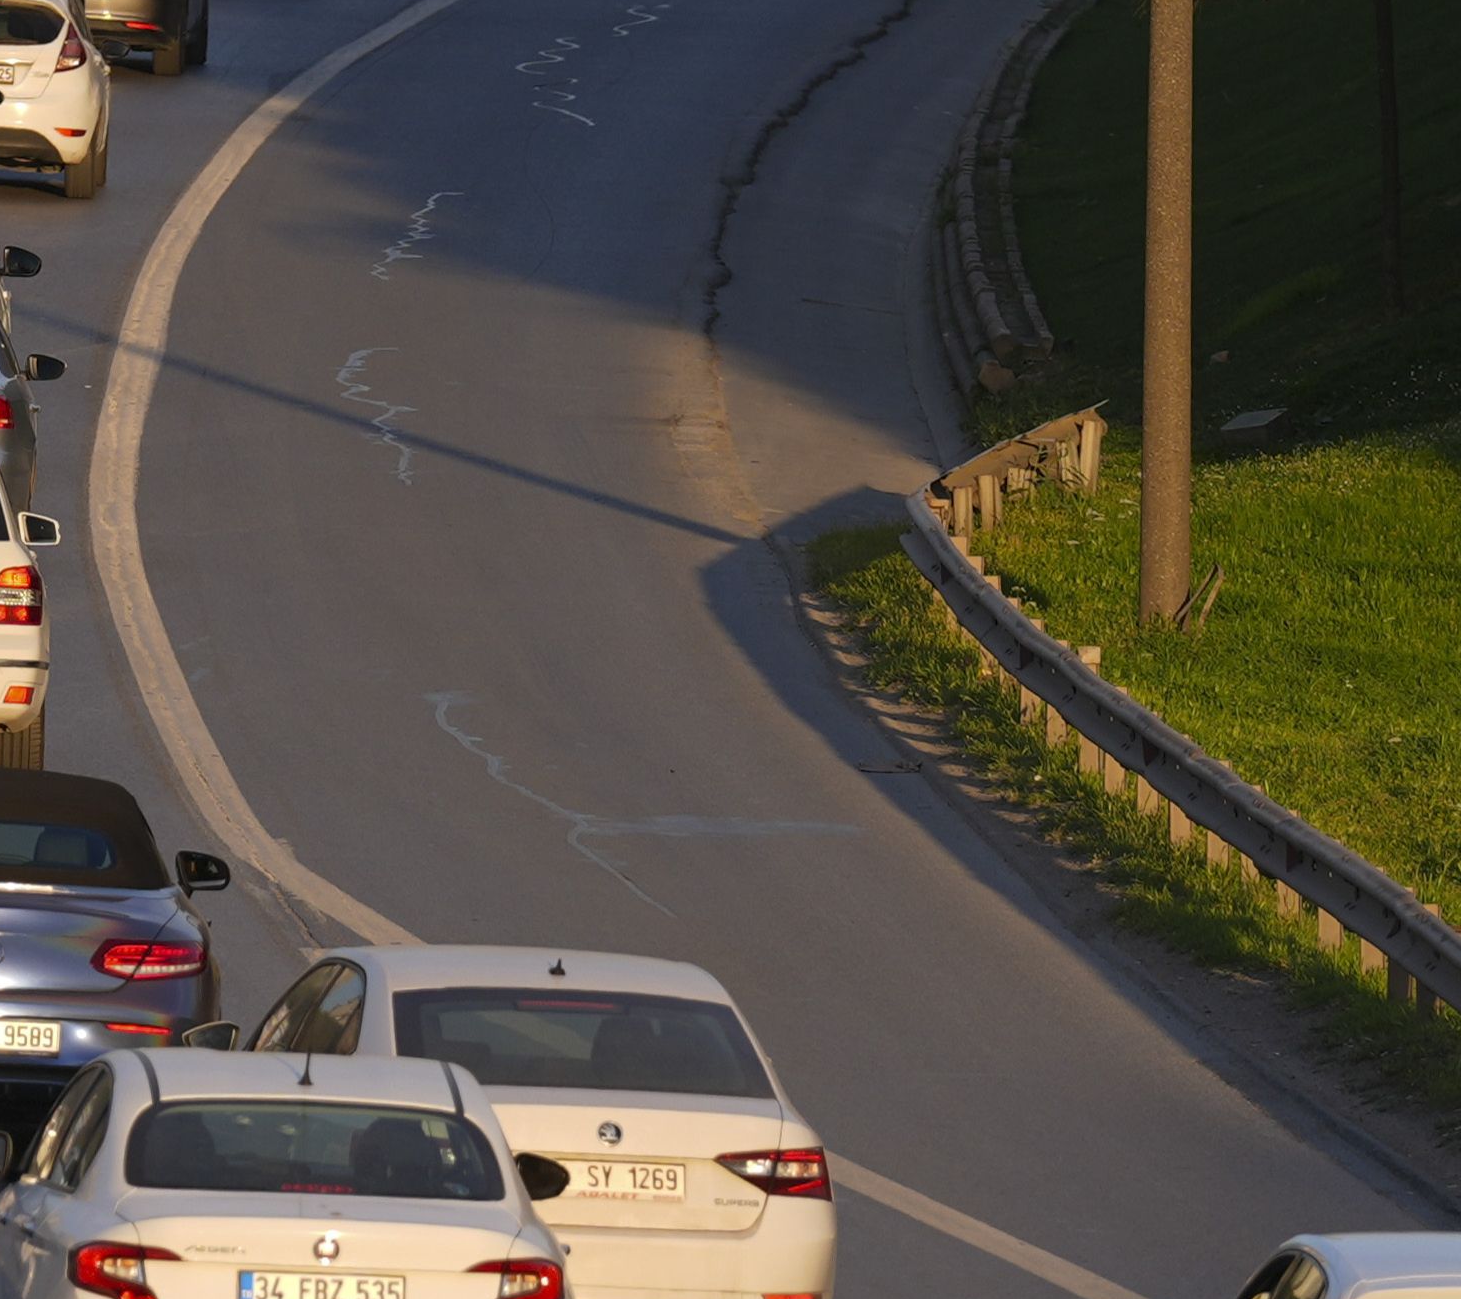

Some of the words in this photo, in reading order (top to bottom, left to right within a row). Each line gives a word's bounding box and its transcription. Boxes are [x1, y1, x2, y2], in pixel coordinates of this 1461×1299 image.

[3, 1024, 53, 1048] 9589
[586, 1165, 613, 1188] SY
[628, 1167, 678, 1192] 1269
